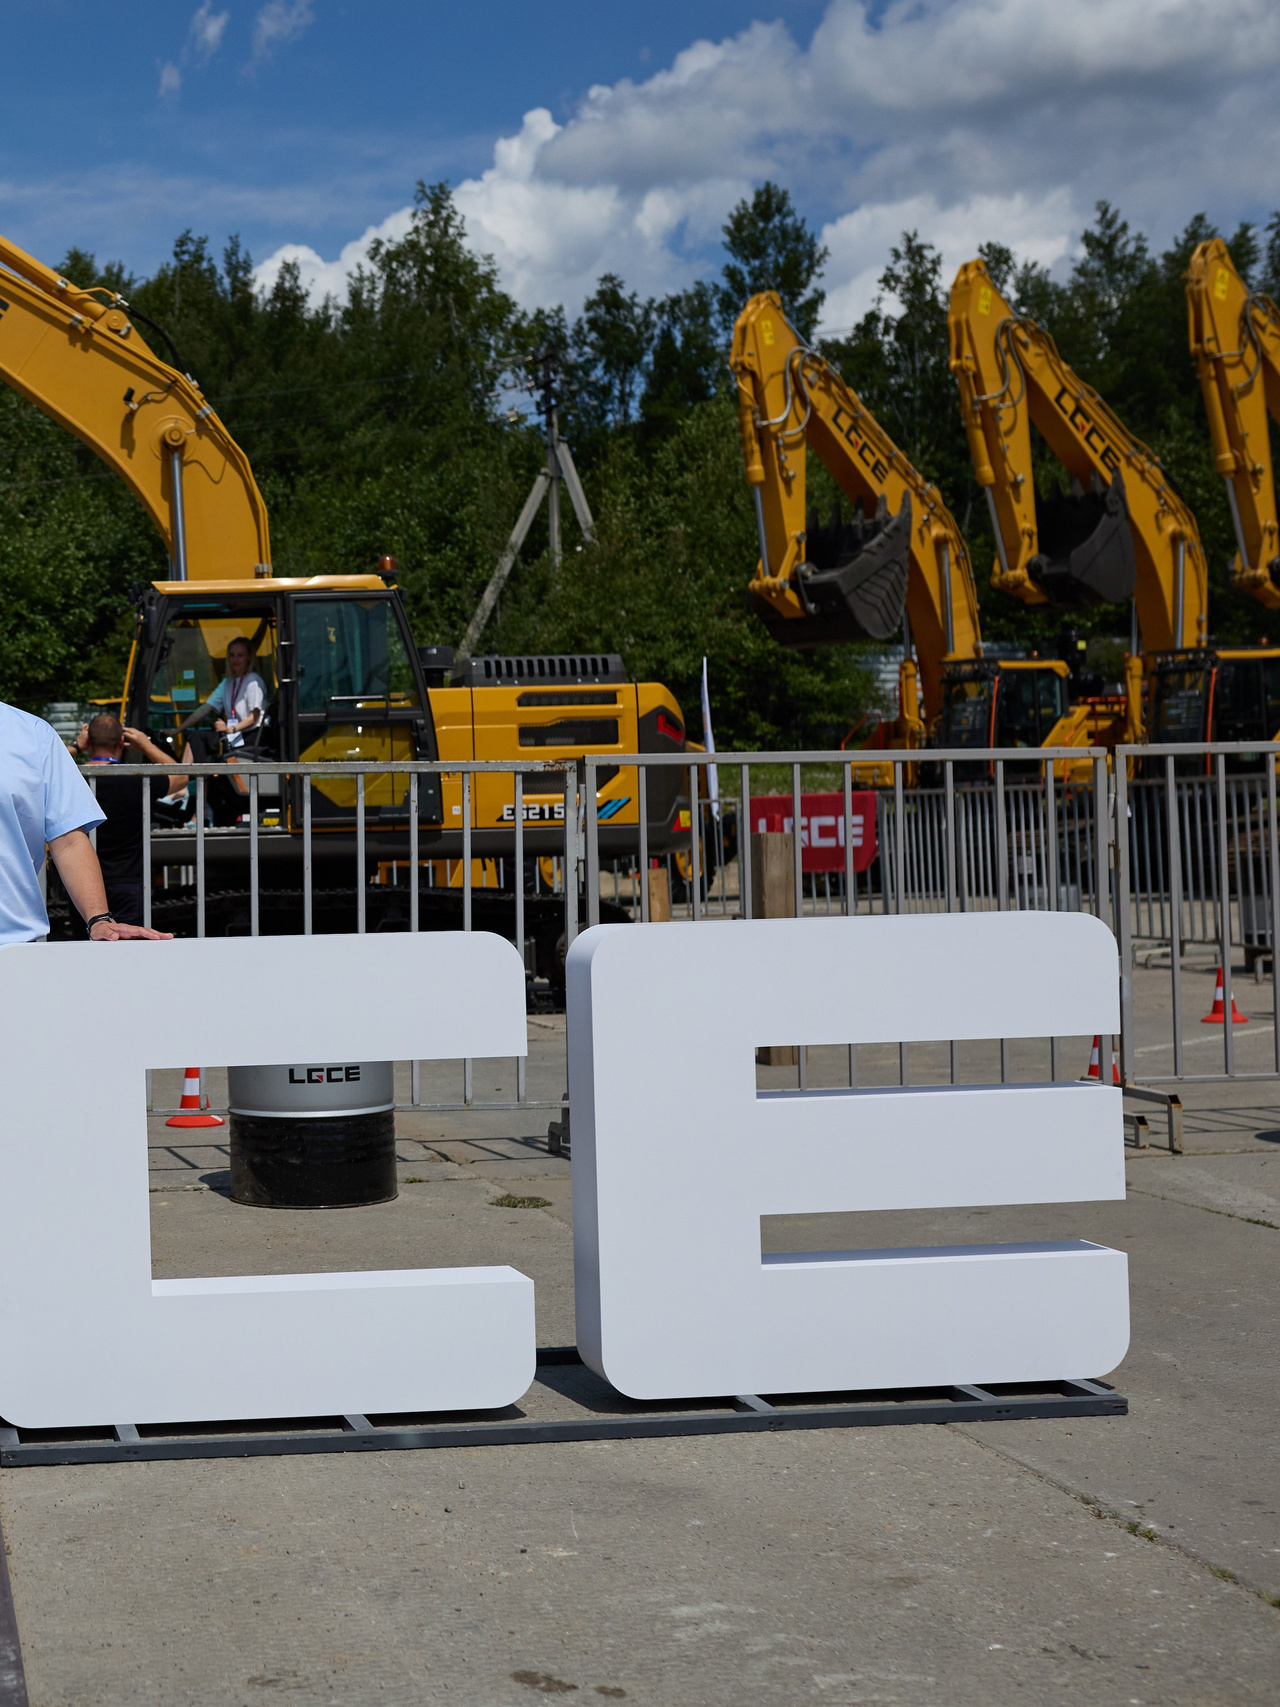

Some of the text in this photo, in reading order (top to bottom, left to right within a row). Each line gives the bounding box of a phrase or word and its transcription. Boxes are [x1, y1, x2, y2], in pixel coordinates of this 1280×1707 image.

[832, 406, 889, 484] LGCE
[1055, 387, 1120, 473] LGCE
[288, 1065, 361, 1084] LGCE
